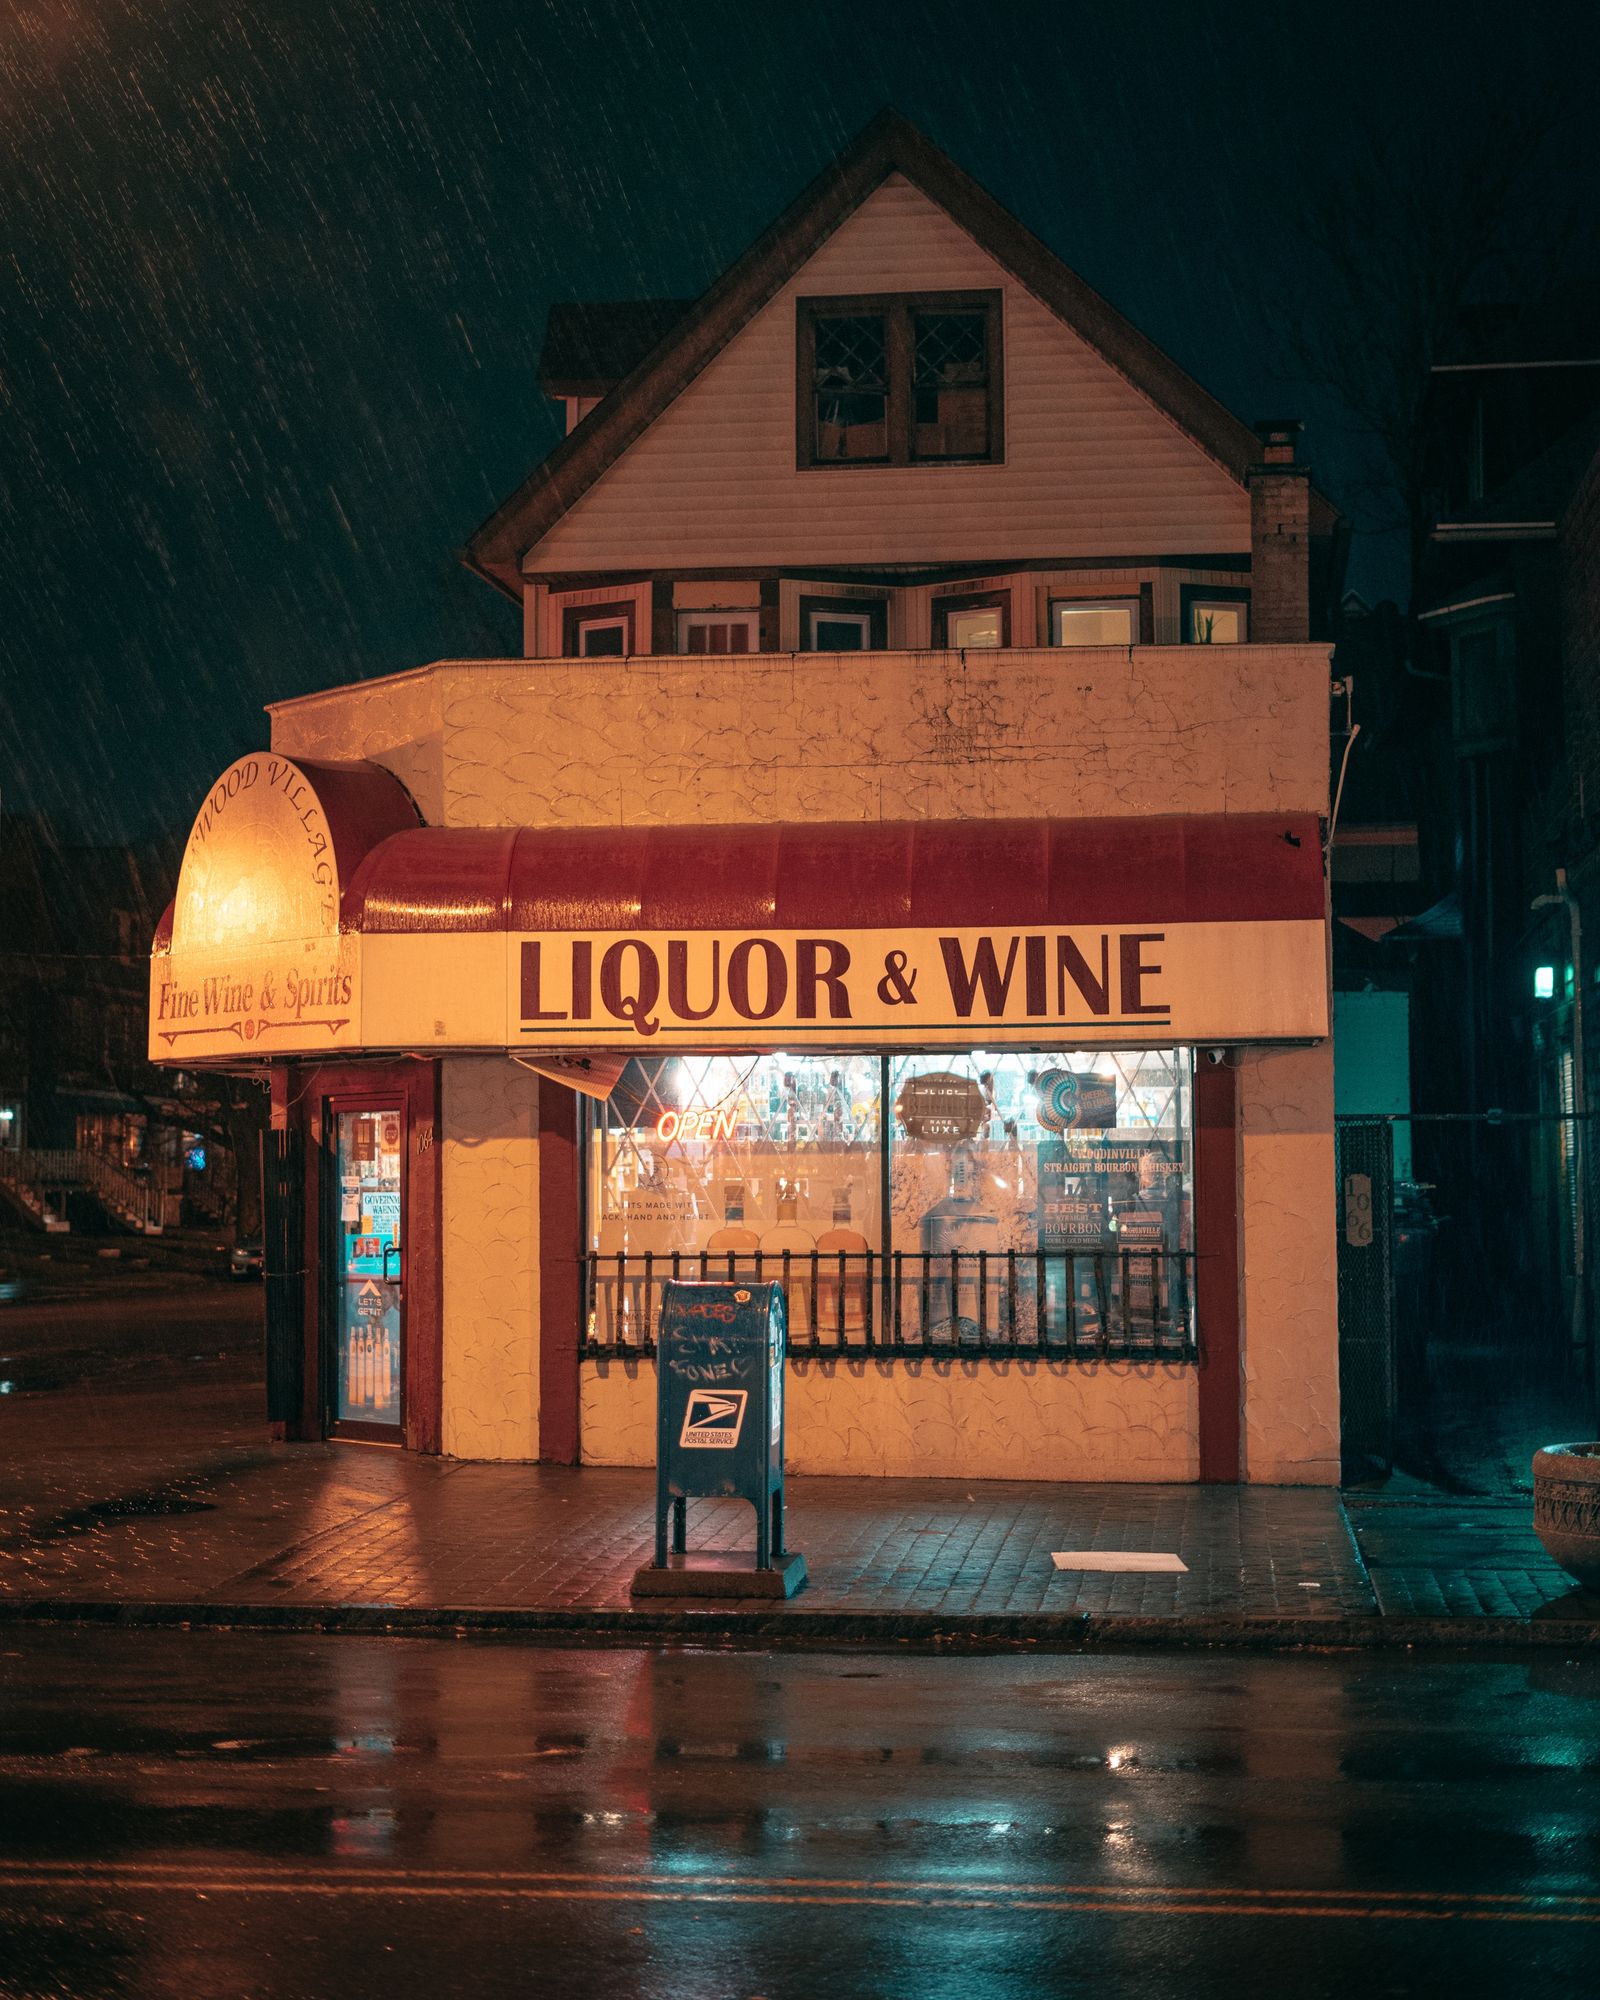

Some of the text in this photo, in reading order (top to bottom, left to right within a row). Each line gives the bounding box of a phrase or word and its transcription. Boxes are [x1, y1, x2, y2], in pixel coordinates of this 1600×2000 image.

[520, 932, 1171, 1036] LIQUOR & WINE
[158, 964, 353, 1020] Fine Wine & Spirits
[657, 1109, 739, 1142] OPEN
[921, 1126, 960, 1134] LUXE
[1044, 1162, 1184, 1172] STRAIGHT BOURBON HISKEY
[1043, 1203, 1102, 1213] BEST
[1347, 1179, 1370, 1240] 1066
[627, 1213, 653, 1221] HAND
[656, 1213, 675, 1221] AND
[1045, 1223, 1101, 1234] BOURBON
[358, 1297, 382, 1306] LET'S
[358, 1307, 382, 1316] GET IT
